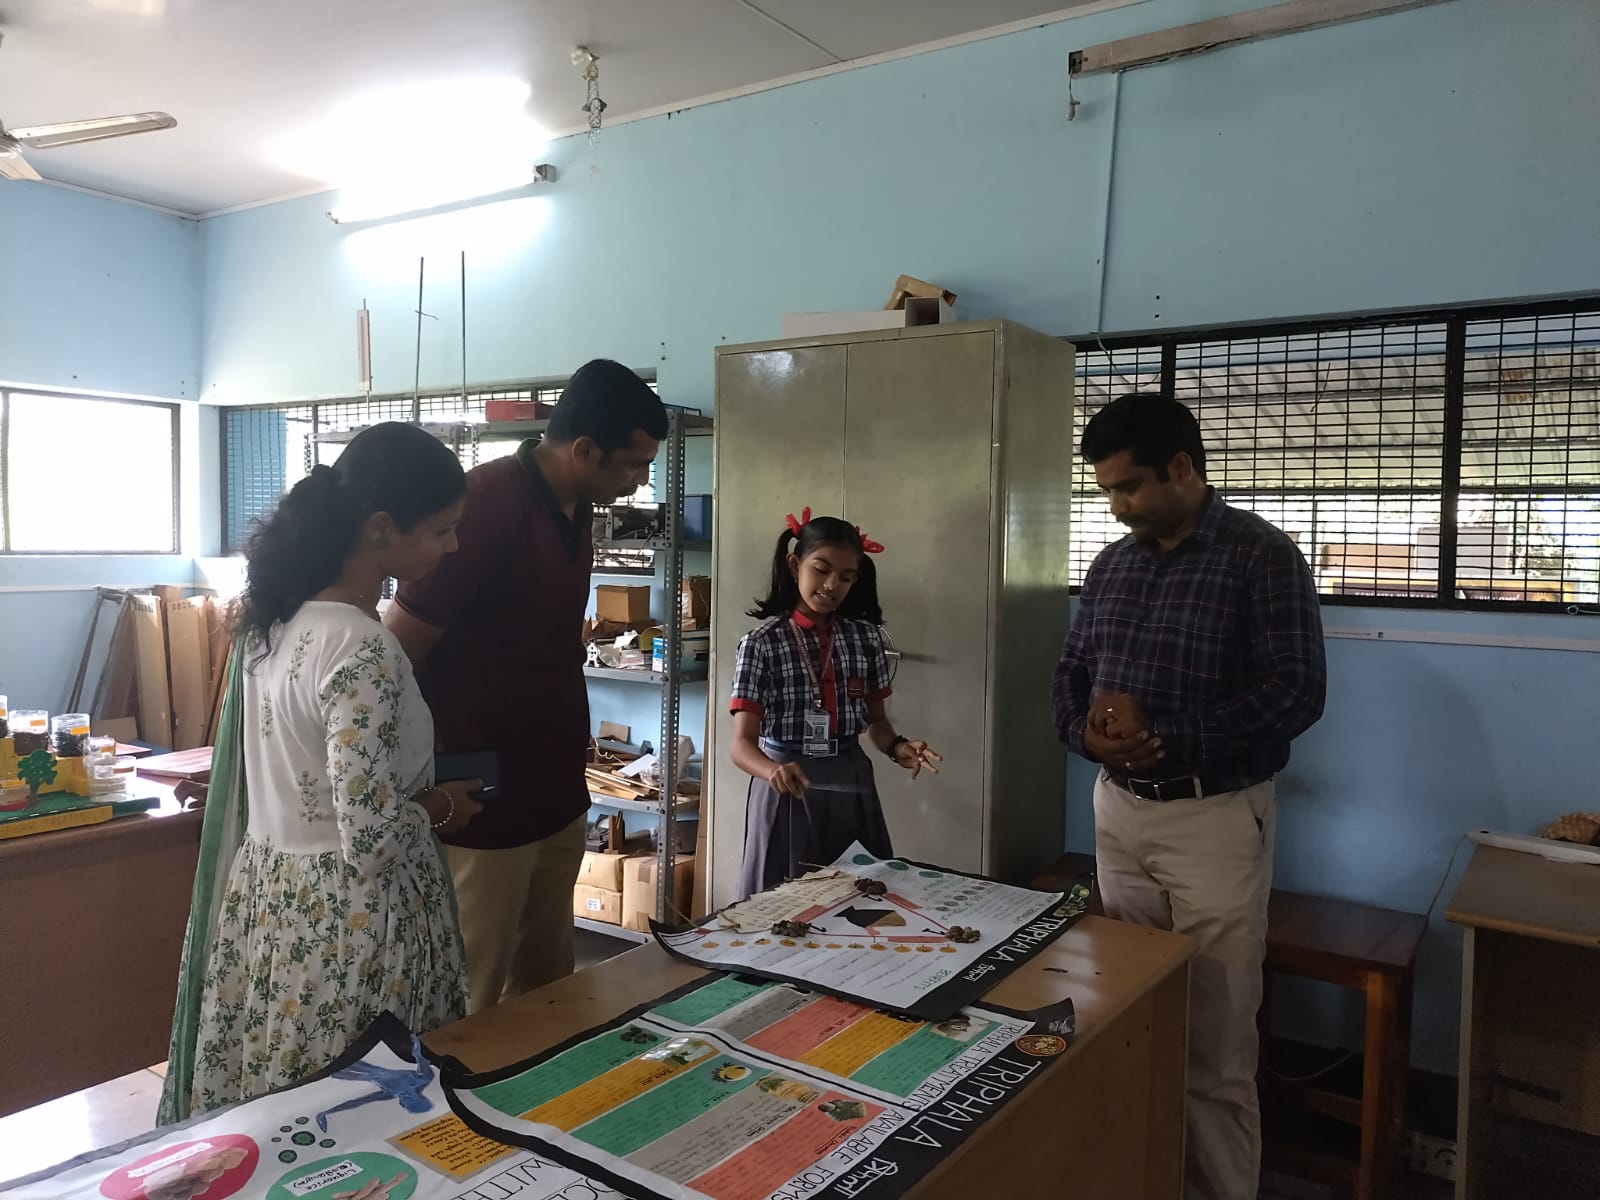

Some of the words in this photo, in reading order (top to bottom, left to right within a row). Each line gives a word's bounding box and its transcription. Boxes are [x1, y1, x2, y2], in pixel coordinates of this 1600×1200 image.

[987, 917, 1068, 962] TRIPHALA
[971, 1022, 1028, 1054] TRIPHALA
[894, 1056, 1043, 1148] TRIPHALA
[901, 1055, 986, 1112] TREATMENTS
[831, 1109, 905, 1165] AVAILABLE
[305, 1168, 357, 1190] Liquorice
